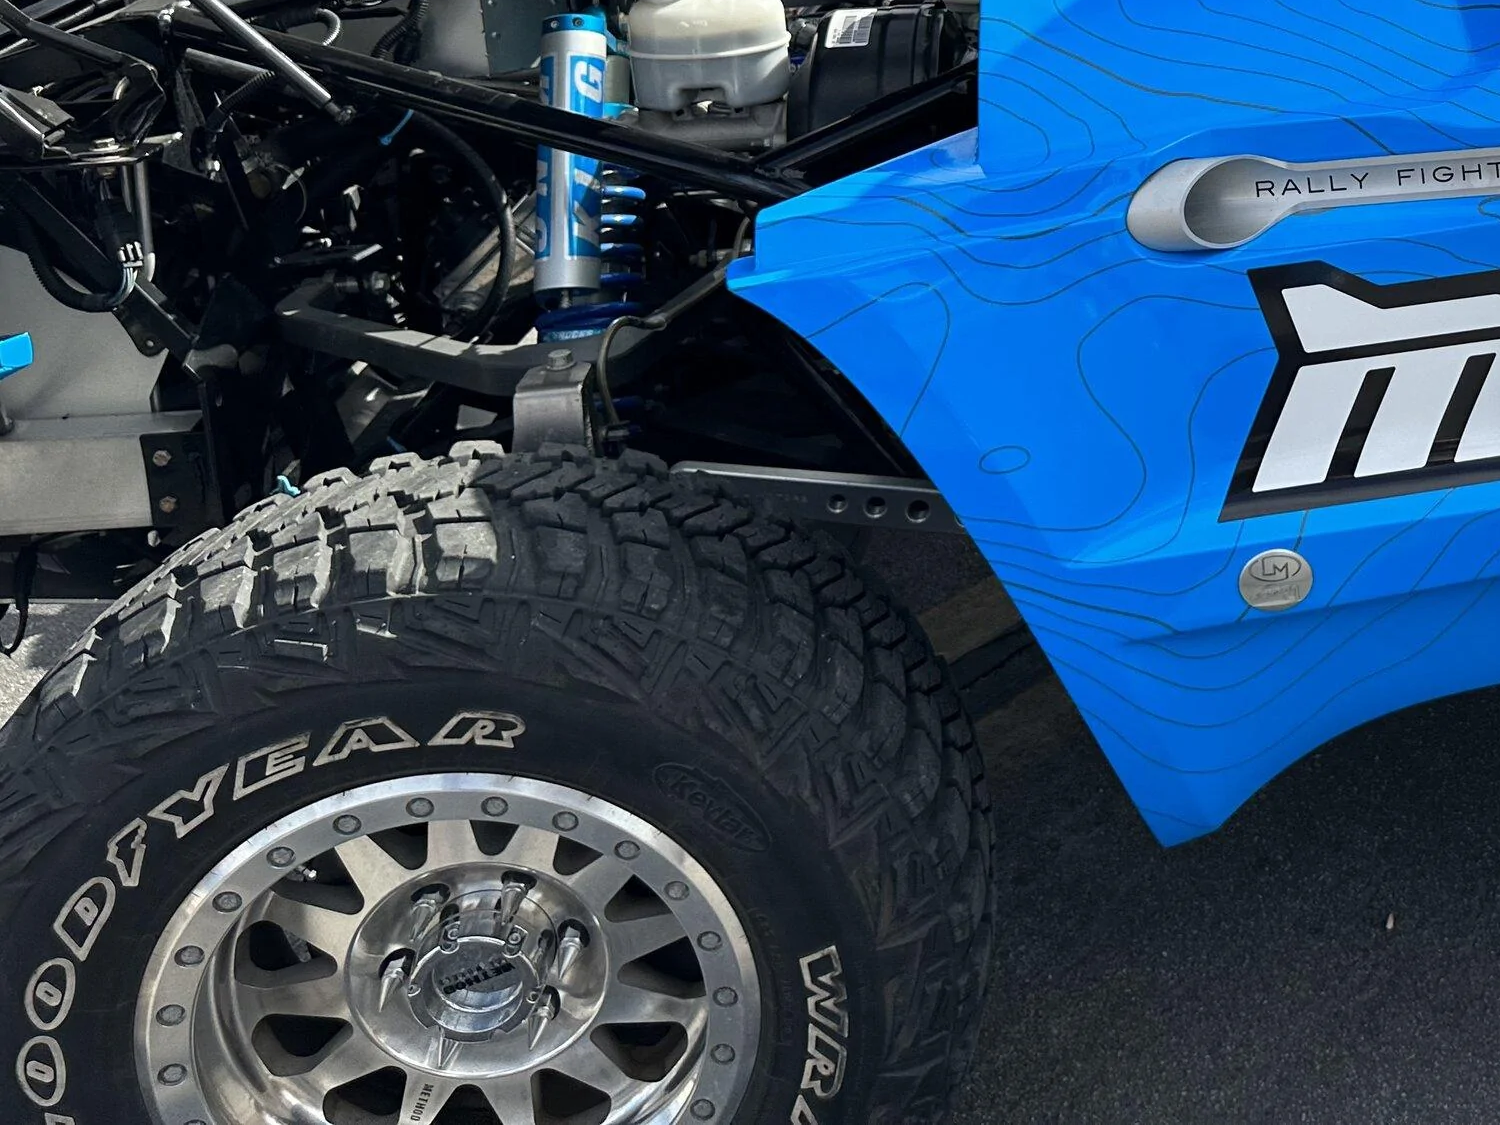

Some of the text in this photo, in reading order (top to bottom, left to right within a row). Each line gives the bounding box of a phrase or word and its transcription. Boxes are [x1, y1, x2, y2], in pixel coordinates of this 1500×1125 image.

[573, 61, 604, 249] KIG
[1255, 172, 1370, 198] RALLY
[410, 1083, 435, 1122] METHOD
